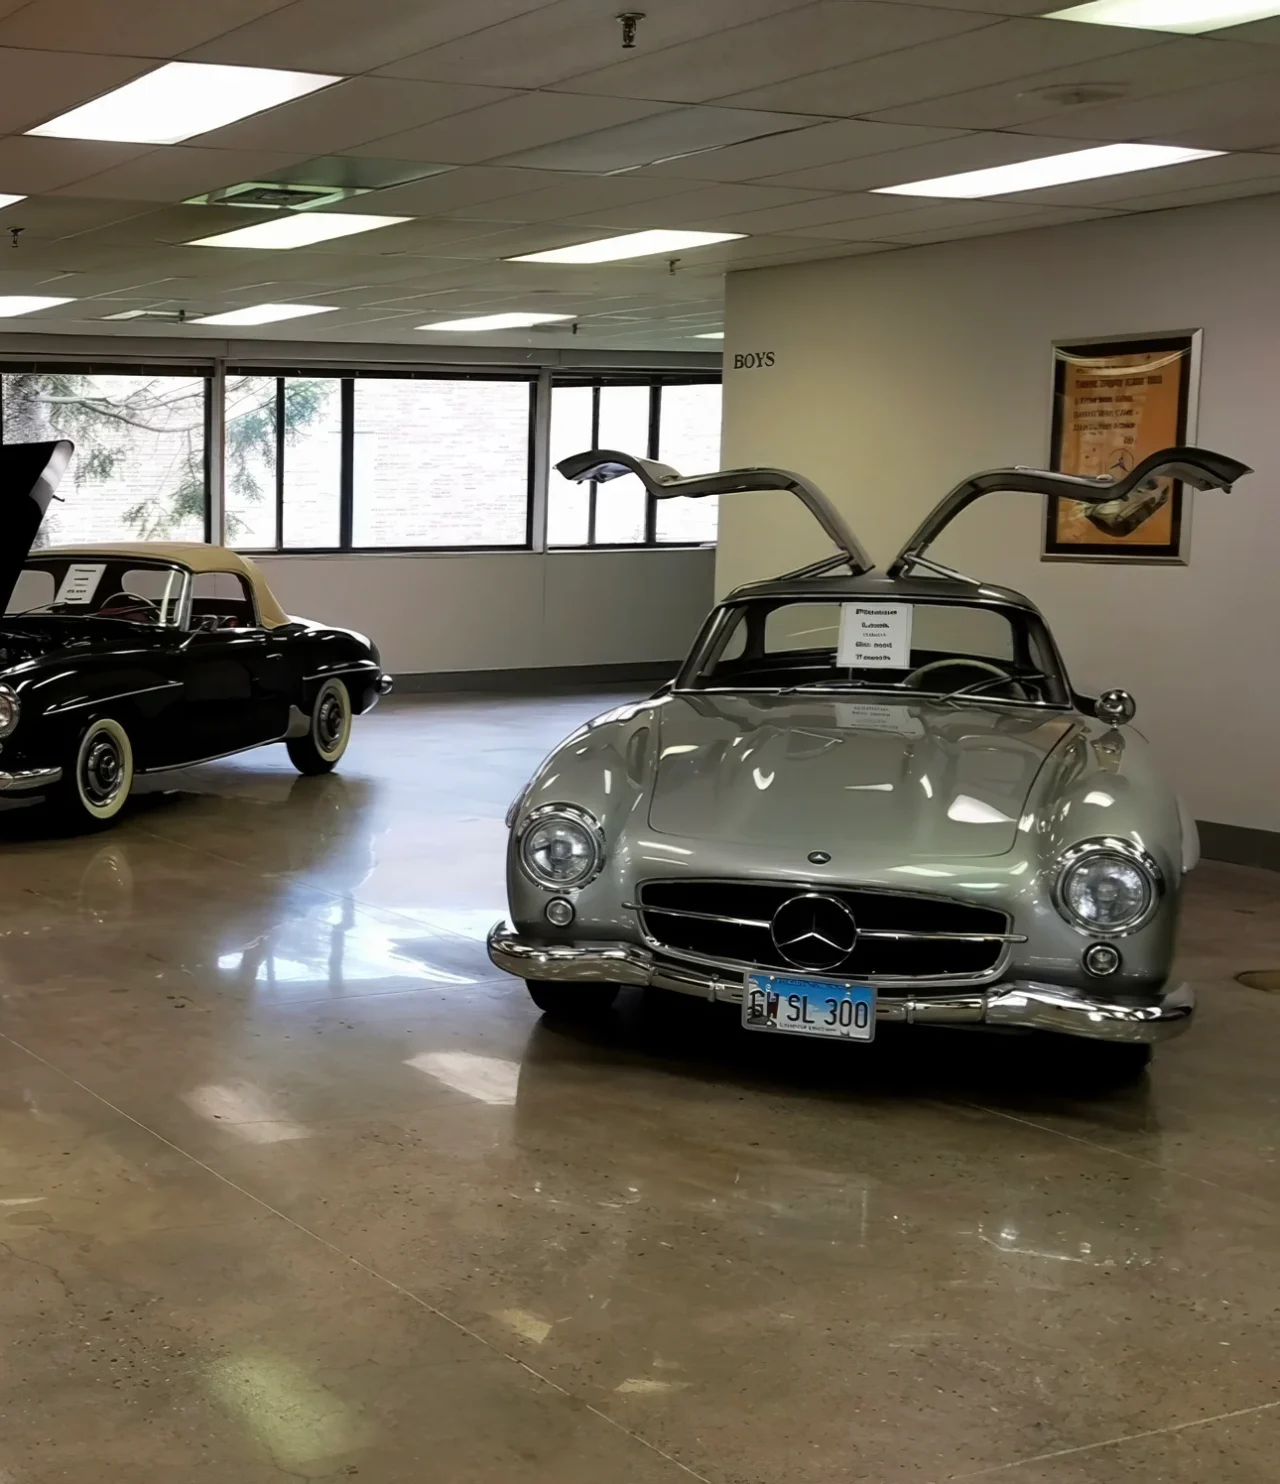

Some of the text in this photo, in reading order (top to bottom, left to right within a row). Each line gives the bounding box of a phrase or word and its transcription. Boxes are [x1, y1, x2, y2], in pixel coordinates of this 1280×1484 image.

[734, 351, 776, 369] BOYS
[786, 994, 815, 1023] SL
[824, 998, 868, 1029] 300
